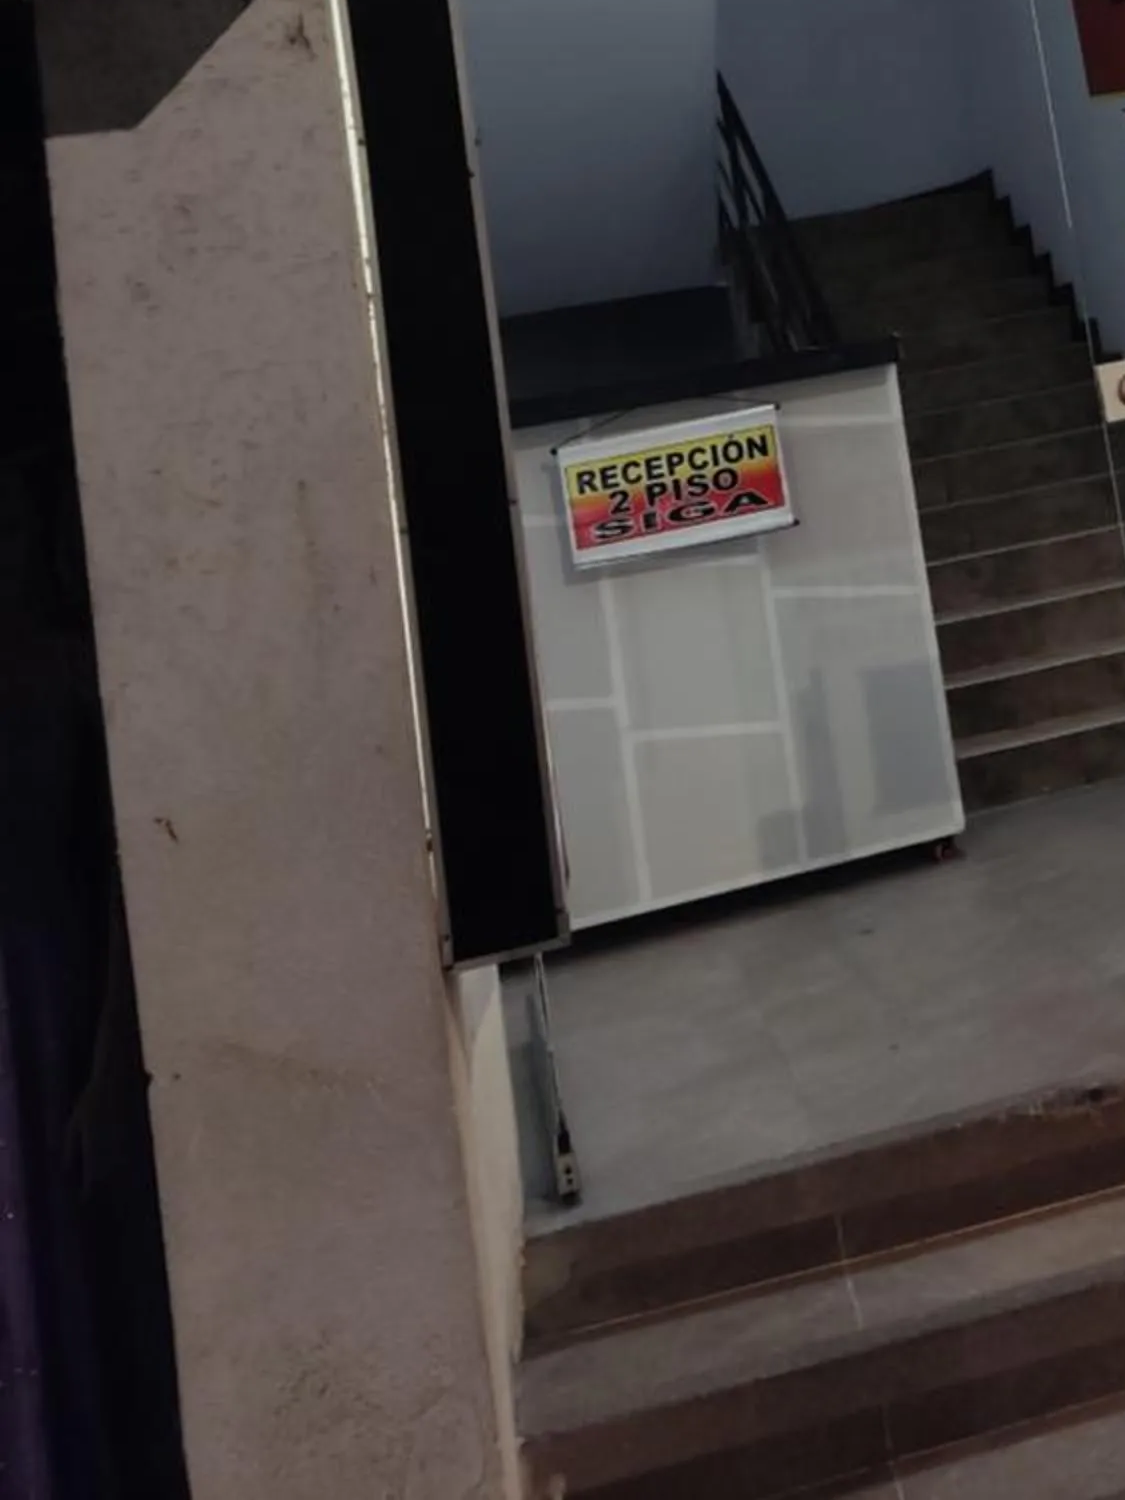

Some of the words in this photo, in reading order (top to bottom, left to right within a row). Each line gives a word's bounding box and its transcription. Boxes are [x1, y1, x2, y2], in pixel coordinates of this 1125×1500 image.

[576, 434, 769, 495] RECEPCIÓN
[593, 491, 769, 539] SIGA
[610, 491, 631, 515] 2
[645, 468, 739, 506] PISO
